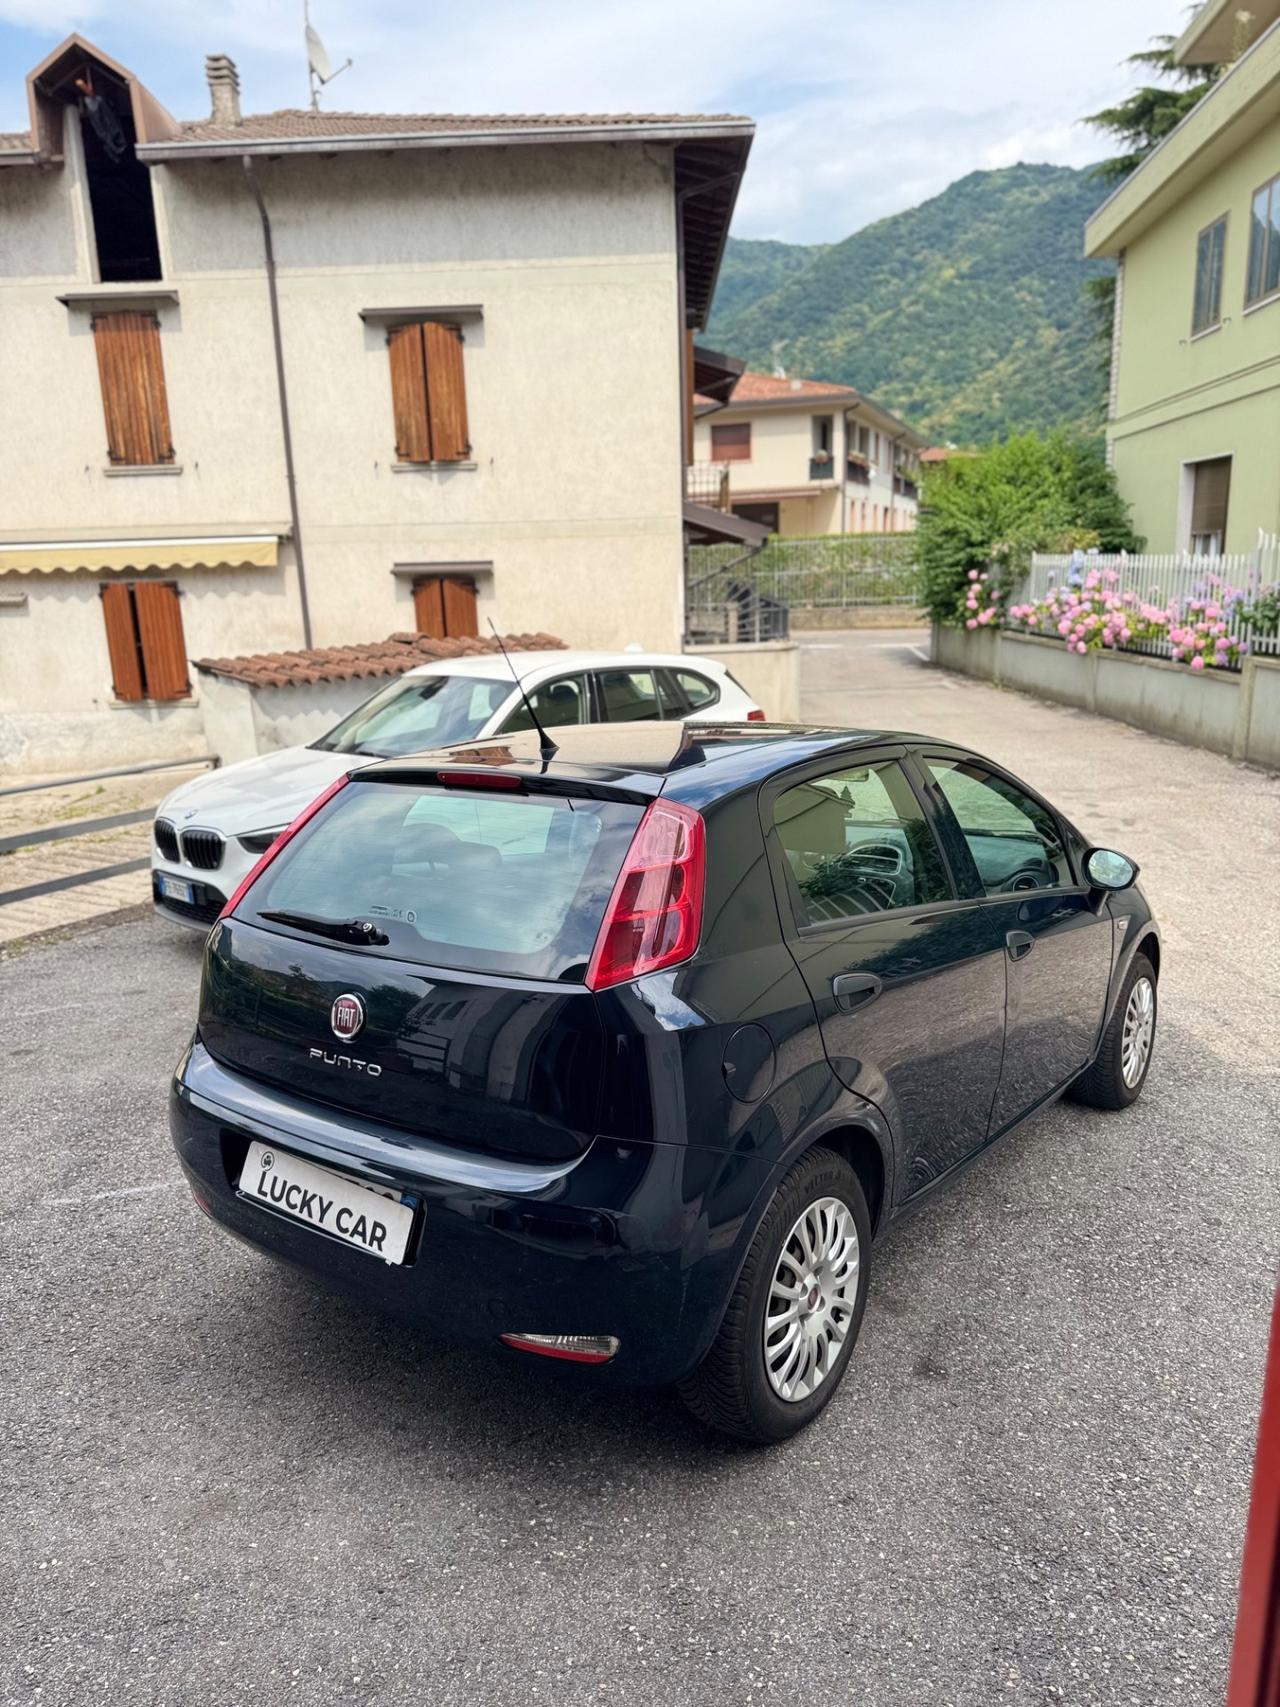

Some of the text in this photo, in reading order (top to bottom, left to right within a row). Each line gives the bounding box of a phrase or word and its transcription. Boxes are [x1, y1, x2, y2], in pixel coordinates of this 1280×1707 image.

[337, 1007, 355, 1027] FIAT
[310, 1048, 381, 1076] PUNTO
[257, 1171, 333, 1223] LUCKY
[336, 1207, 387, 1252] CAR
